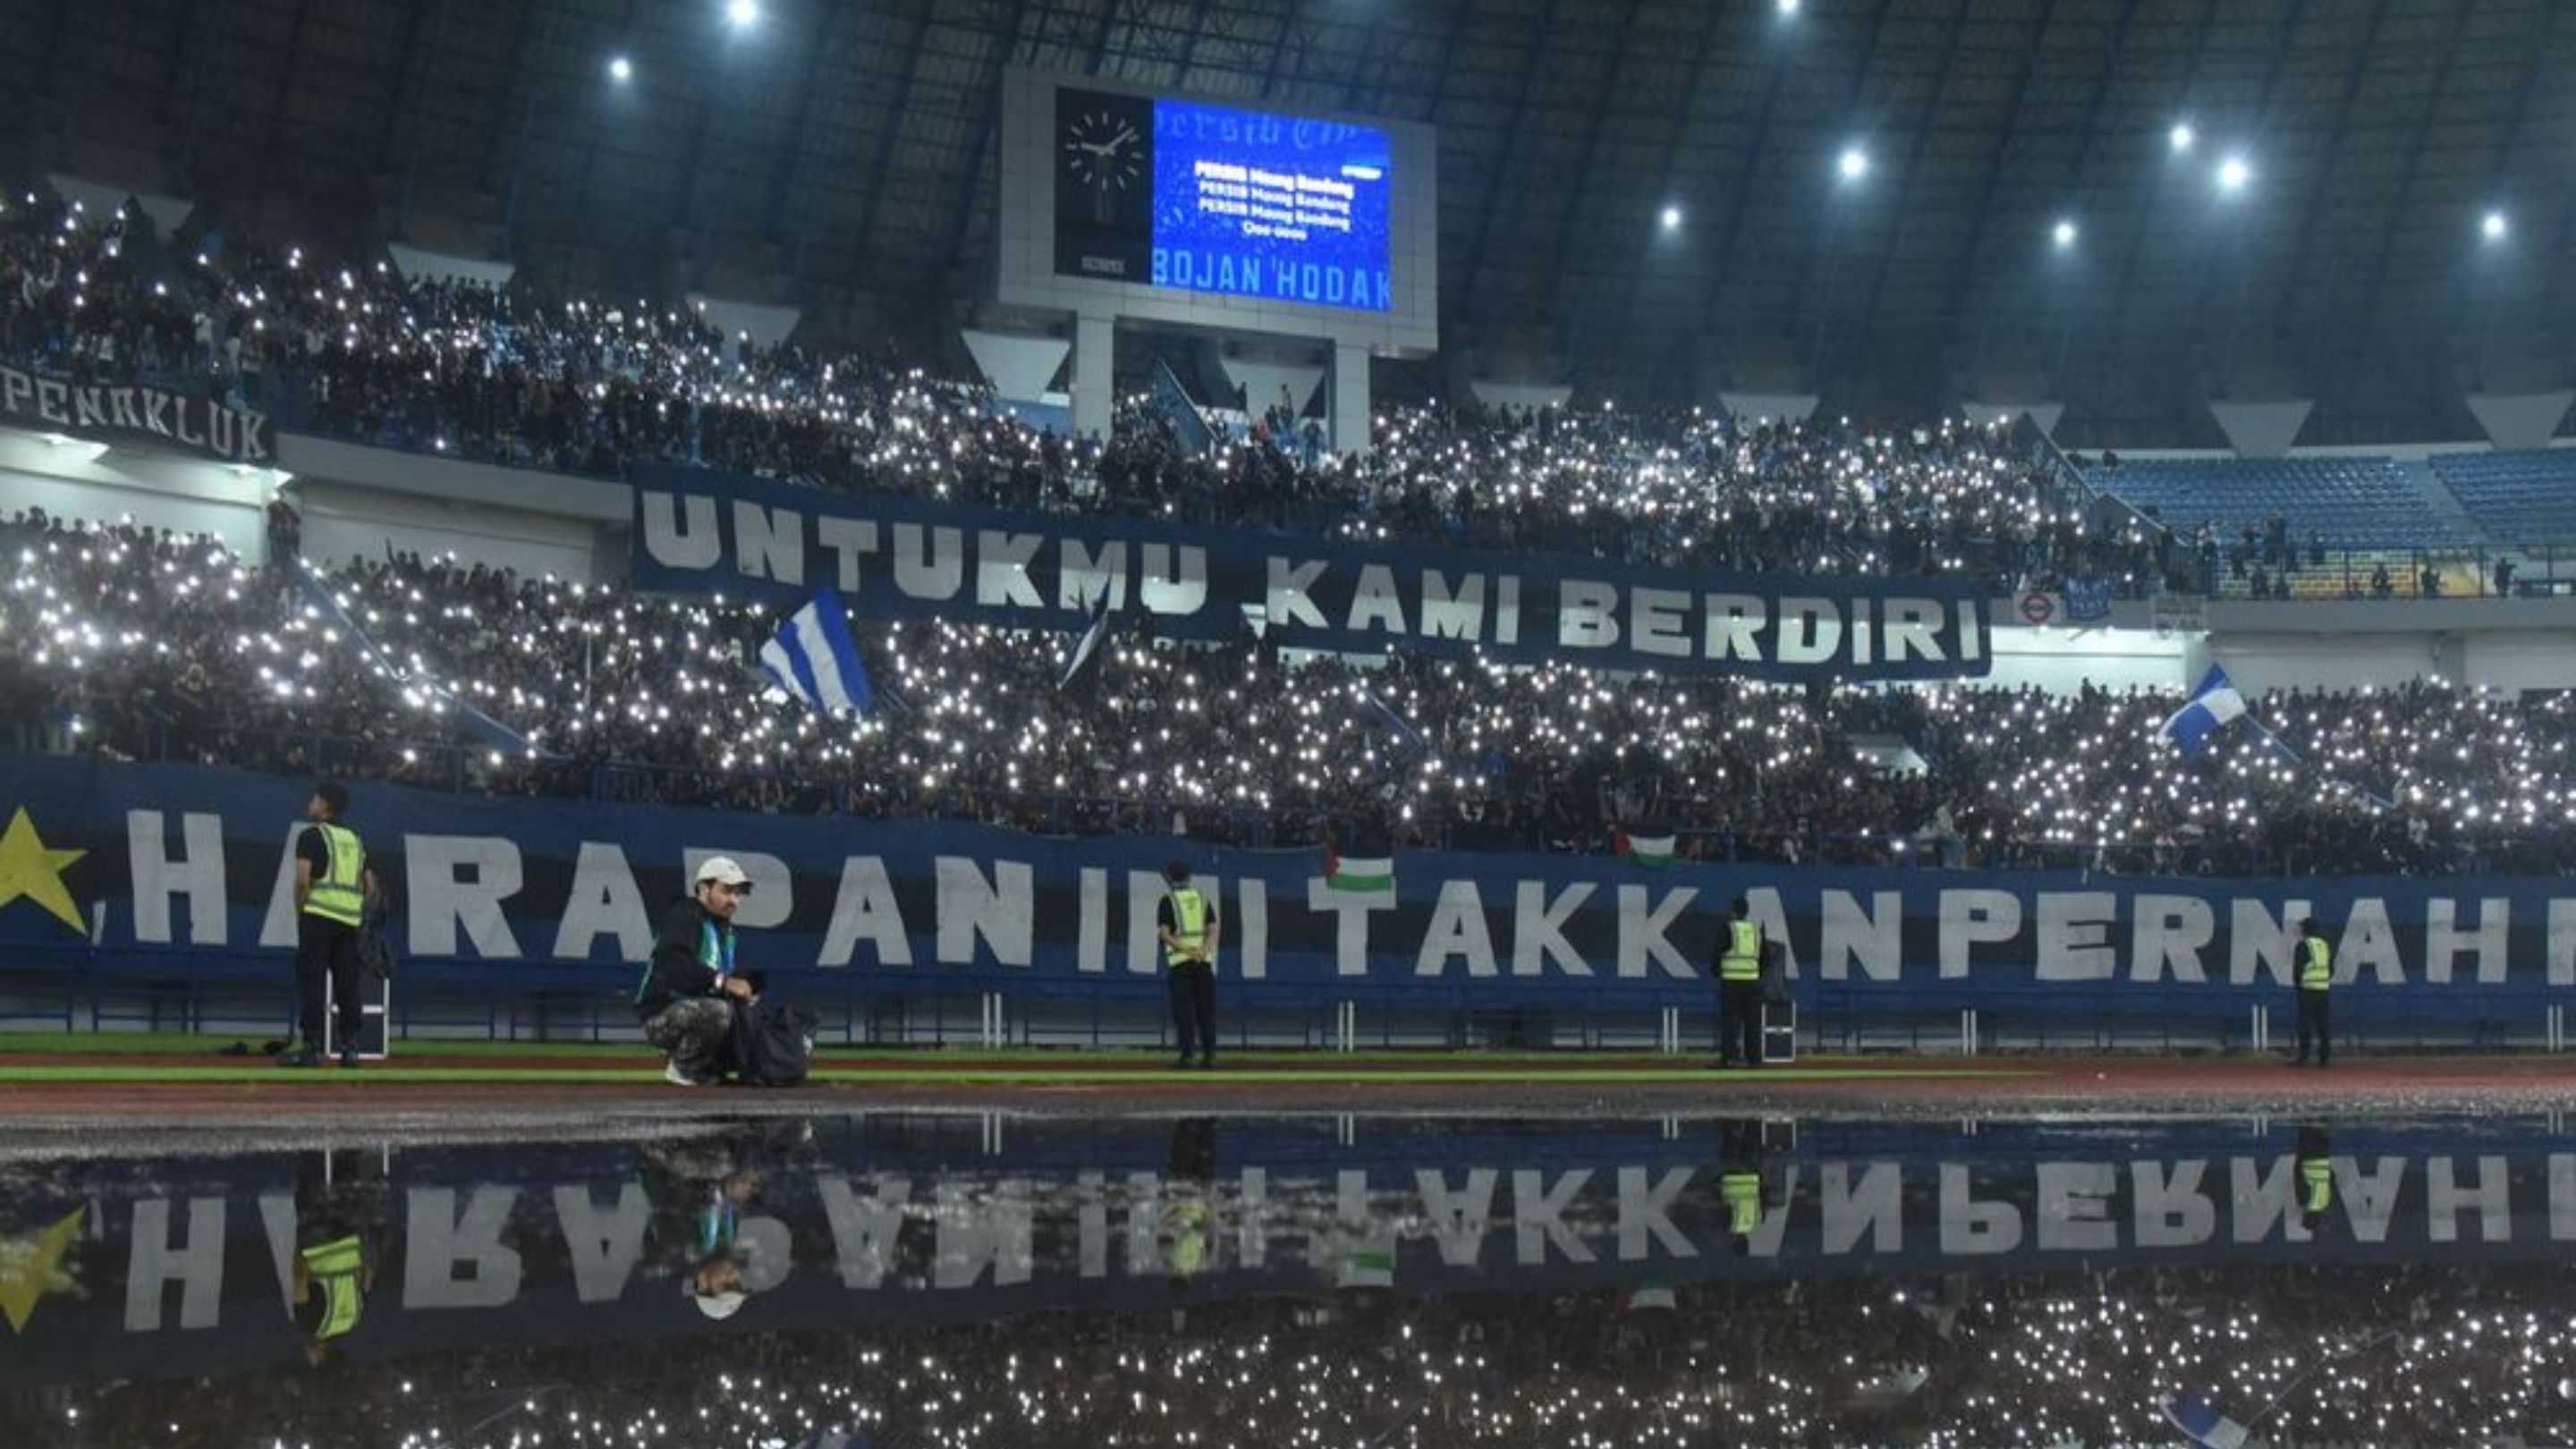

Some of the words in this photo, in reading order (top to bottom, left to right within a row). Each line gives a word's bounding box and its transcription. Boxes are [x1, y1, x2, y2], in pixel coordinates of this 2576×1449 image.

[1153, 247, 1260, 293] BOJAN
[1276, 259, 1393, 310] HODAK
[2, 366, 267, 460] PENAKLUK
[642, 491, 1208, 615] UNTUKMU
[1266, 555, 1521, 644] KAMI
[1558, 579, 1980, 665] BERDIRI
[1939, 889, 2510, 985] PERNAH
